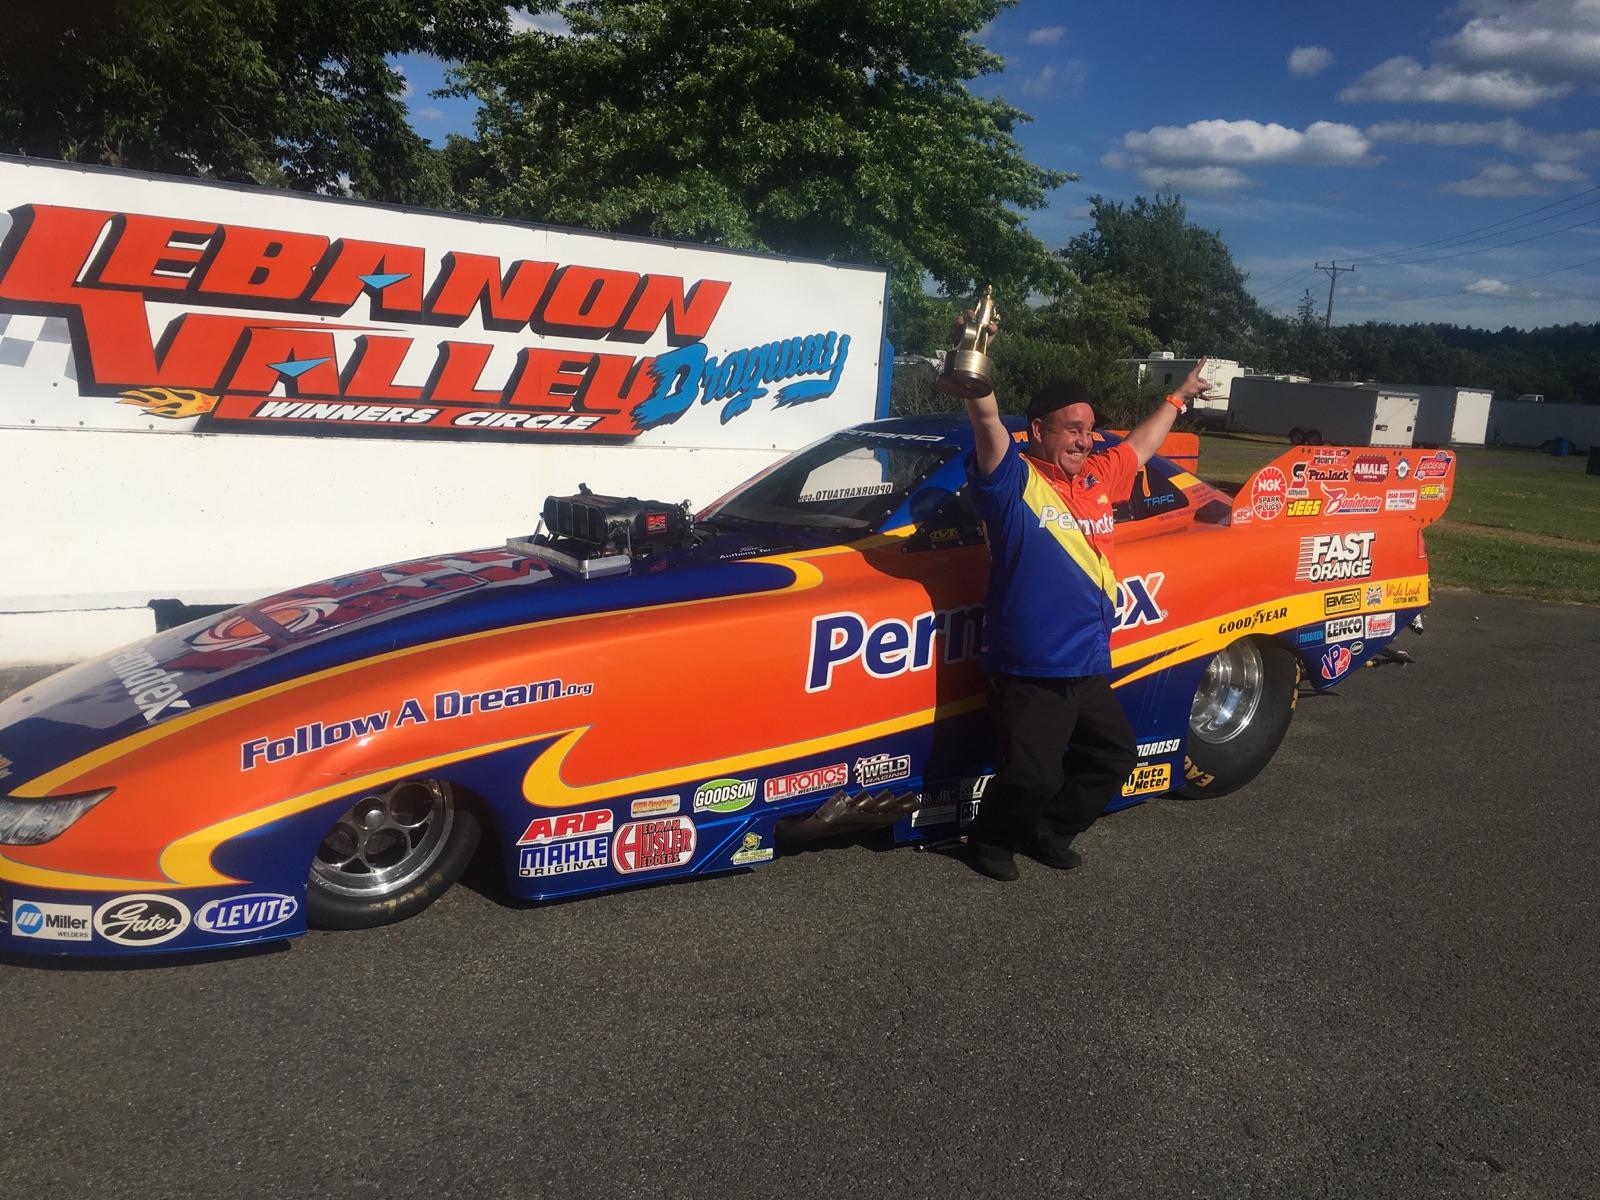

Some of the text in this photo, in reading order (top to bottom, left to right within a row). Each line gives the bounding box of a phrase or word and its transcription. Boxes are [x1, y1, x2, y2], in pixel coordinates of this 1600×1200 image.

[0, 203, 731, 346] LEBANON
[78, 303, 658, 437] VALLEY
[632, 331, 851, 430] Dragway
[256, 401, 601, 431] WINNERS CIRCLE
[1354, 464, 1389, 474] AMALIE
[1258, 479, 1281, 491] NGK
[1144, 494, 1175, 508] TAFC
[1258, 496, 1280, 504] SPARK
[1258, 503, 1280, 511] PLUGS
[1287, 500, 1322, 517] JEGS
[1038, 506, 1114, 535] Permate
[1310, 532, 1376, 564] FAST
[1308, 558, 1374, 582] ORANGE
[1327, 592, 1353, 607] BME
[1218, 607, 1288, 634] GOODYEAR
[1327, 618, 1362, 637] LENCO
[1321, 643, 1342, 679] VP
[108, 645, 192, 722] ermatex
[241, 678, 593, 772] Follow A Dream.org
[864, 758, 908, 778] WELD
[865, 771, 908, 784] RACING
[1137, 768, 1164, 780] Auto
[695, 780, 755, 808] GOODSON
[1134, 777, 1168, 790] Meter
[520, 809, 612, 841] ARP
[520, 838, 607, 869] MAHLE
[520, 858, 606, 876] ORIGINAL
[46, 913, 88, 930] Miller
[104, 902, 185, 937] Gates
[198, 895, 296, 931] CLEVITE
[57, 931, 88, 939] WELDERS
